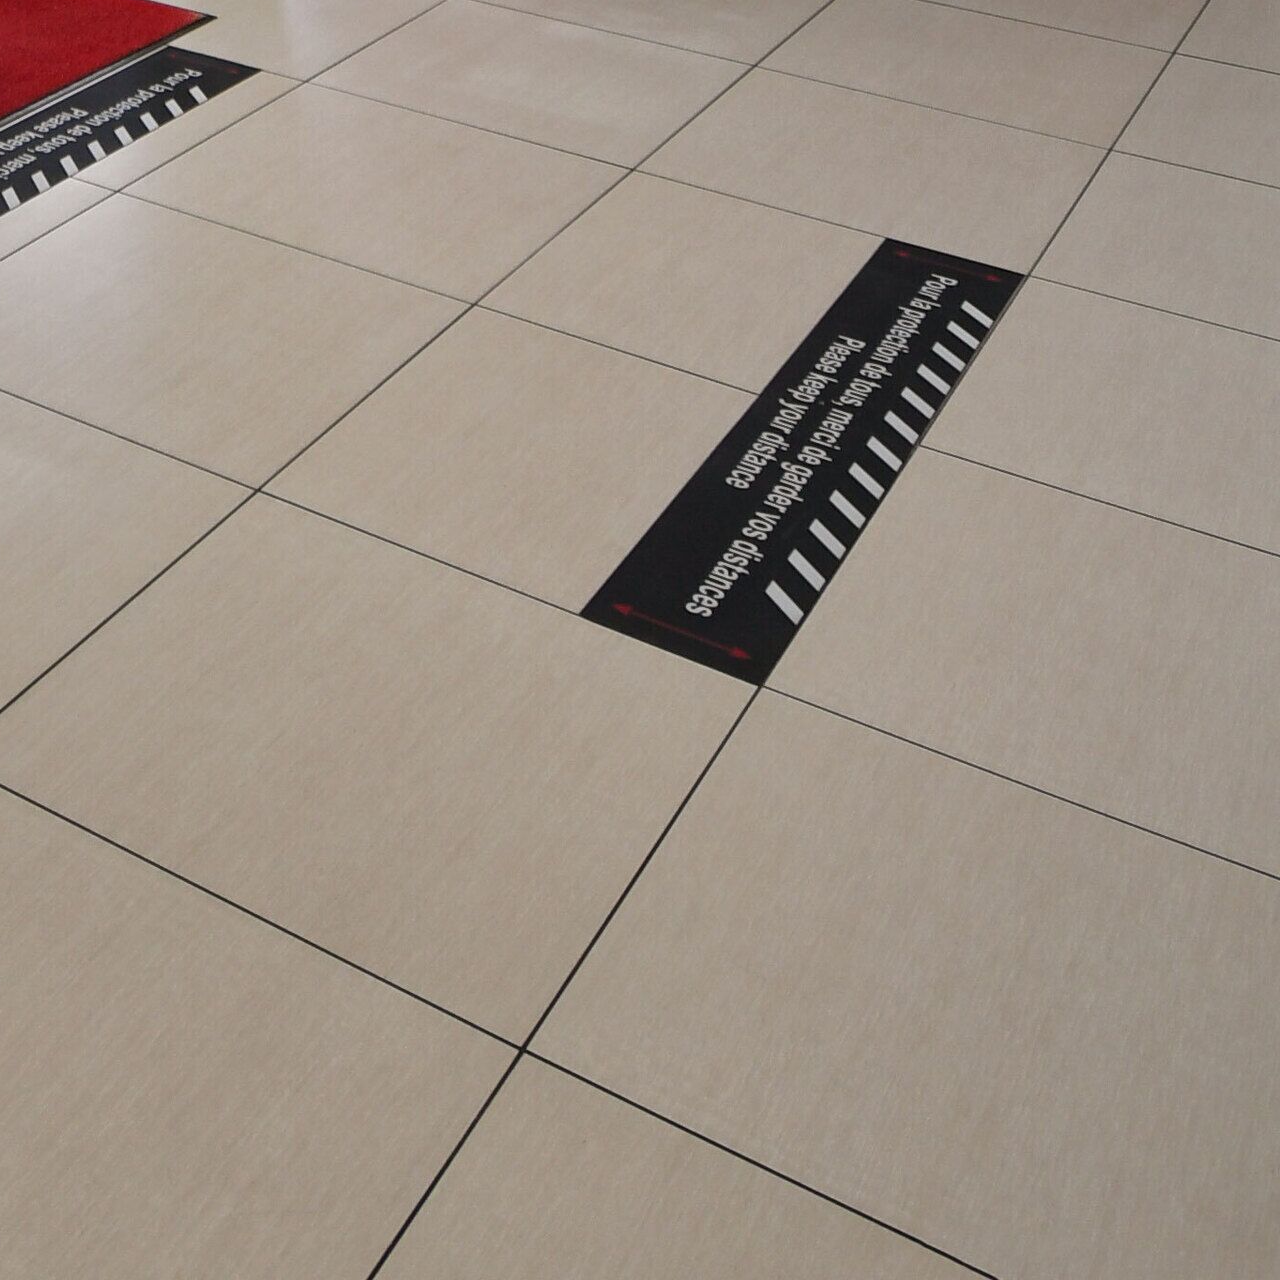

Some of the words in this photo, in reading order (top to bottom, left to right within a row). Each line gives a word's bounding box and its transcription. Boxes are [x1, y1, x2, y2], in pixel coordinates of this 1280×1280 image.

[149, 81, 174, 93] la
[164, 68, 203, 87] Pour
[33, 107, 89, 134] Please
[85, 88, 156, 127] protection
[67, 123, 93, 137] de
[917, 273, 959, 301] Pour
[909, 297, 942, 311] la
[870, 306, 926, 364] protection
[814, 334, 867, 376] Please
[859, 362, 893, 380] de
[787, 371, 839, 404] keep
[770, 397, 809, 436] your
[809, 407, 854, 451] merci
[725, 431, 790, 489] distance
[797, 445, 833, 466] de
[763, 461, 814, 514] garder
[741, 511, 781, 541] vos
[685, 539, 765, 617] distances
